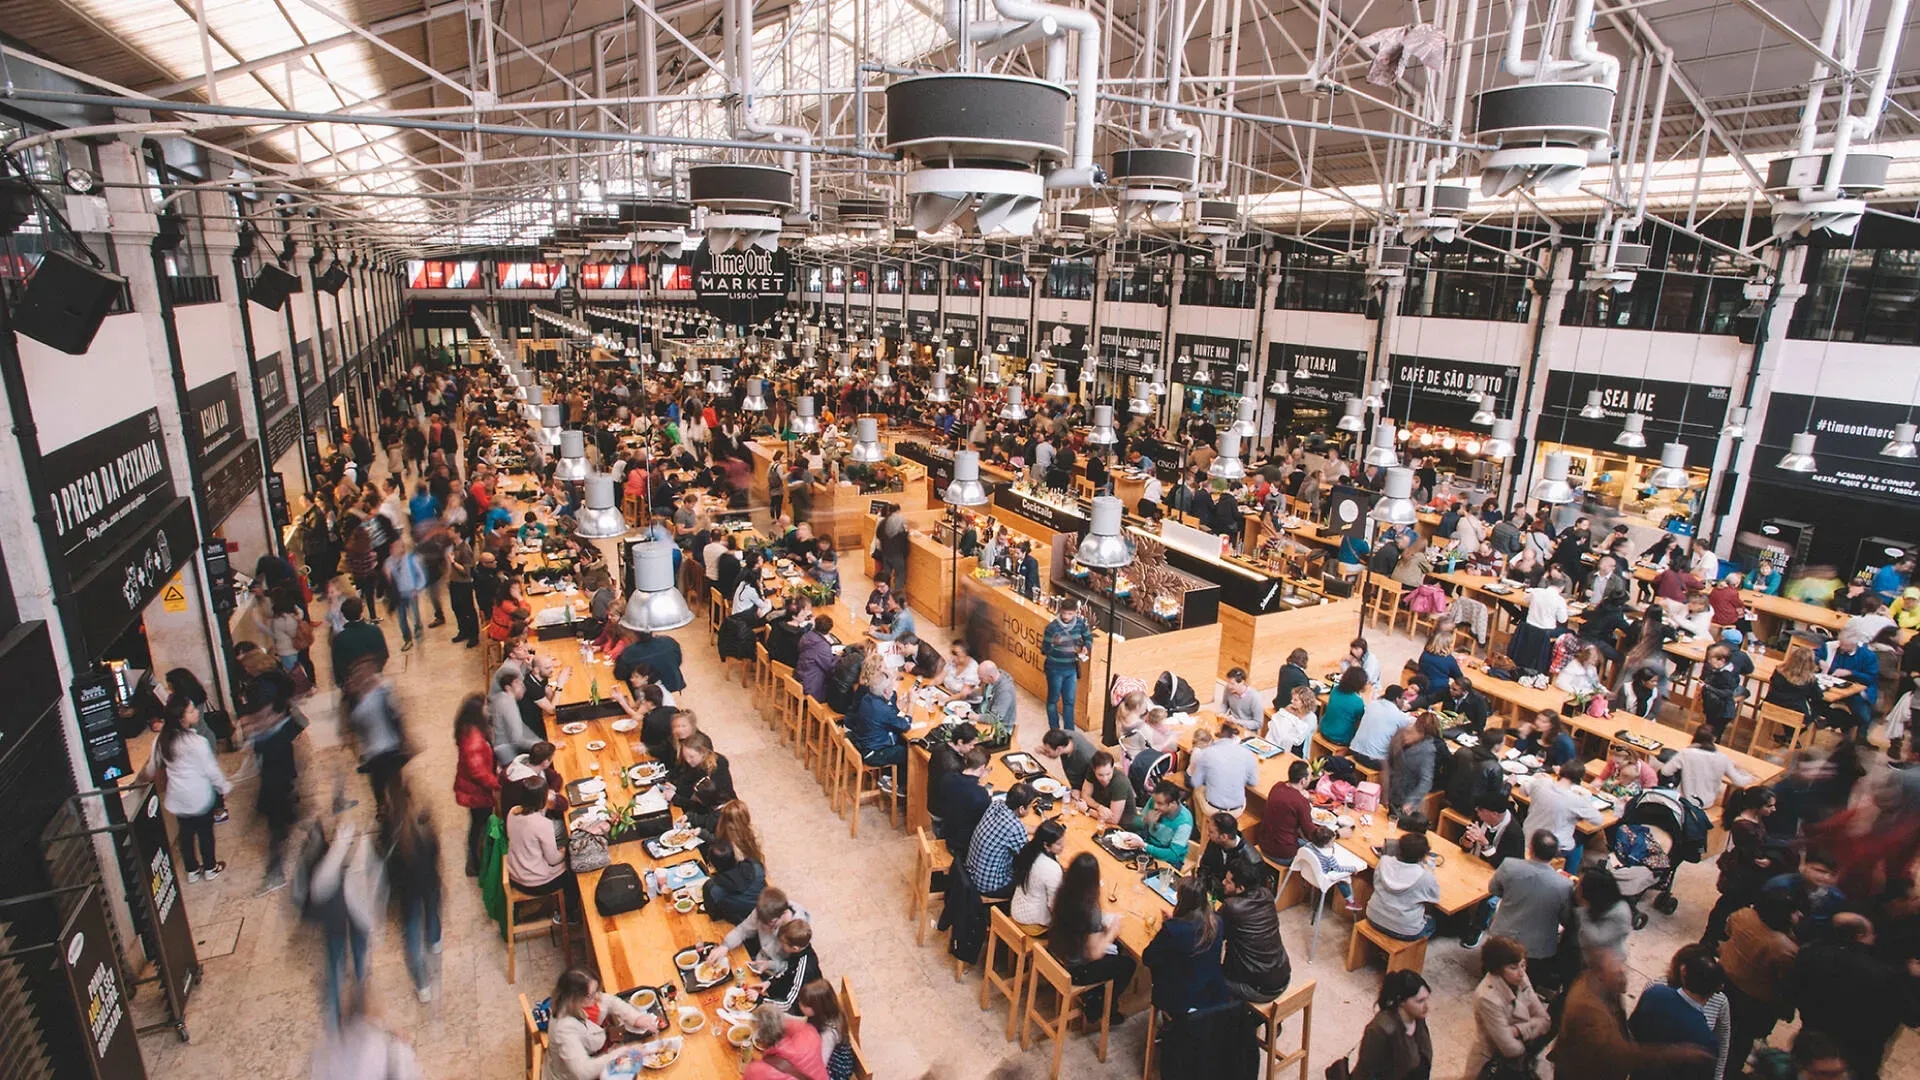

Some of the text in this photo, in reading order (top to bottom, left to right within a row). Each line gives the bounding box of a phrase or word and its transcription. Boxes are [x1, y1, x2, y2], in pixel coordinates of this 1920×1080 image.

[701, 278, 784, 291] MARKET
[728, 292, 760, 301] LISBOA
[1101, 333, 1121, 347] COZINHA
[1130, 337, 1161, 351] LICIDADE
[1193, 343, 1230, 360] MONTE MAR
[1294, 354, 1337, 373] TTAR-IA
[1400, 366, 1503, 394] CAFÉ DE SÃO BTO
[1602, 388, 1656, 412] SEA ME
[1816, 419, 1920, 443] #timeoutmercd
[60, 471, 104, 531] PREGO
[99, 462, 121, 505] DA
[116, 439, 163, 495] PEIXARIA
[1836, 471, 1916, 489] ACABOU DE COMER?
[1889, 486, 1920, 498] TABULE
[1022, 498, 1053, 519] Cocktails
[1002, 613, 1043, 651] HOUSE
[1000, 632, 1044, 674] TEQUIL
